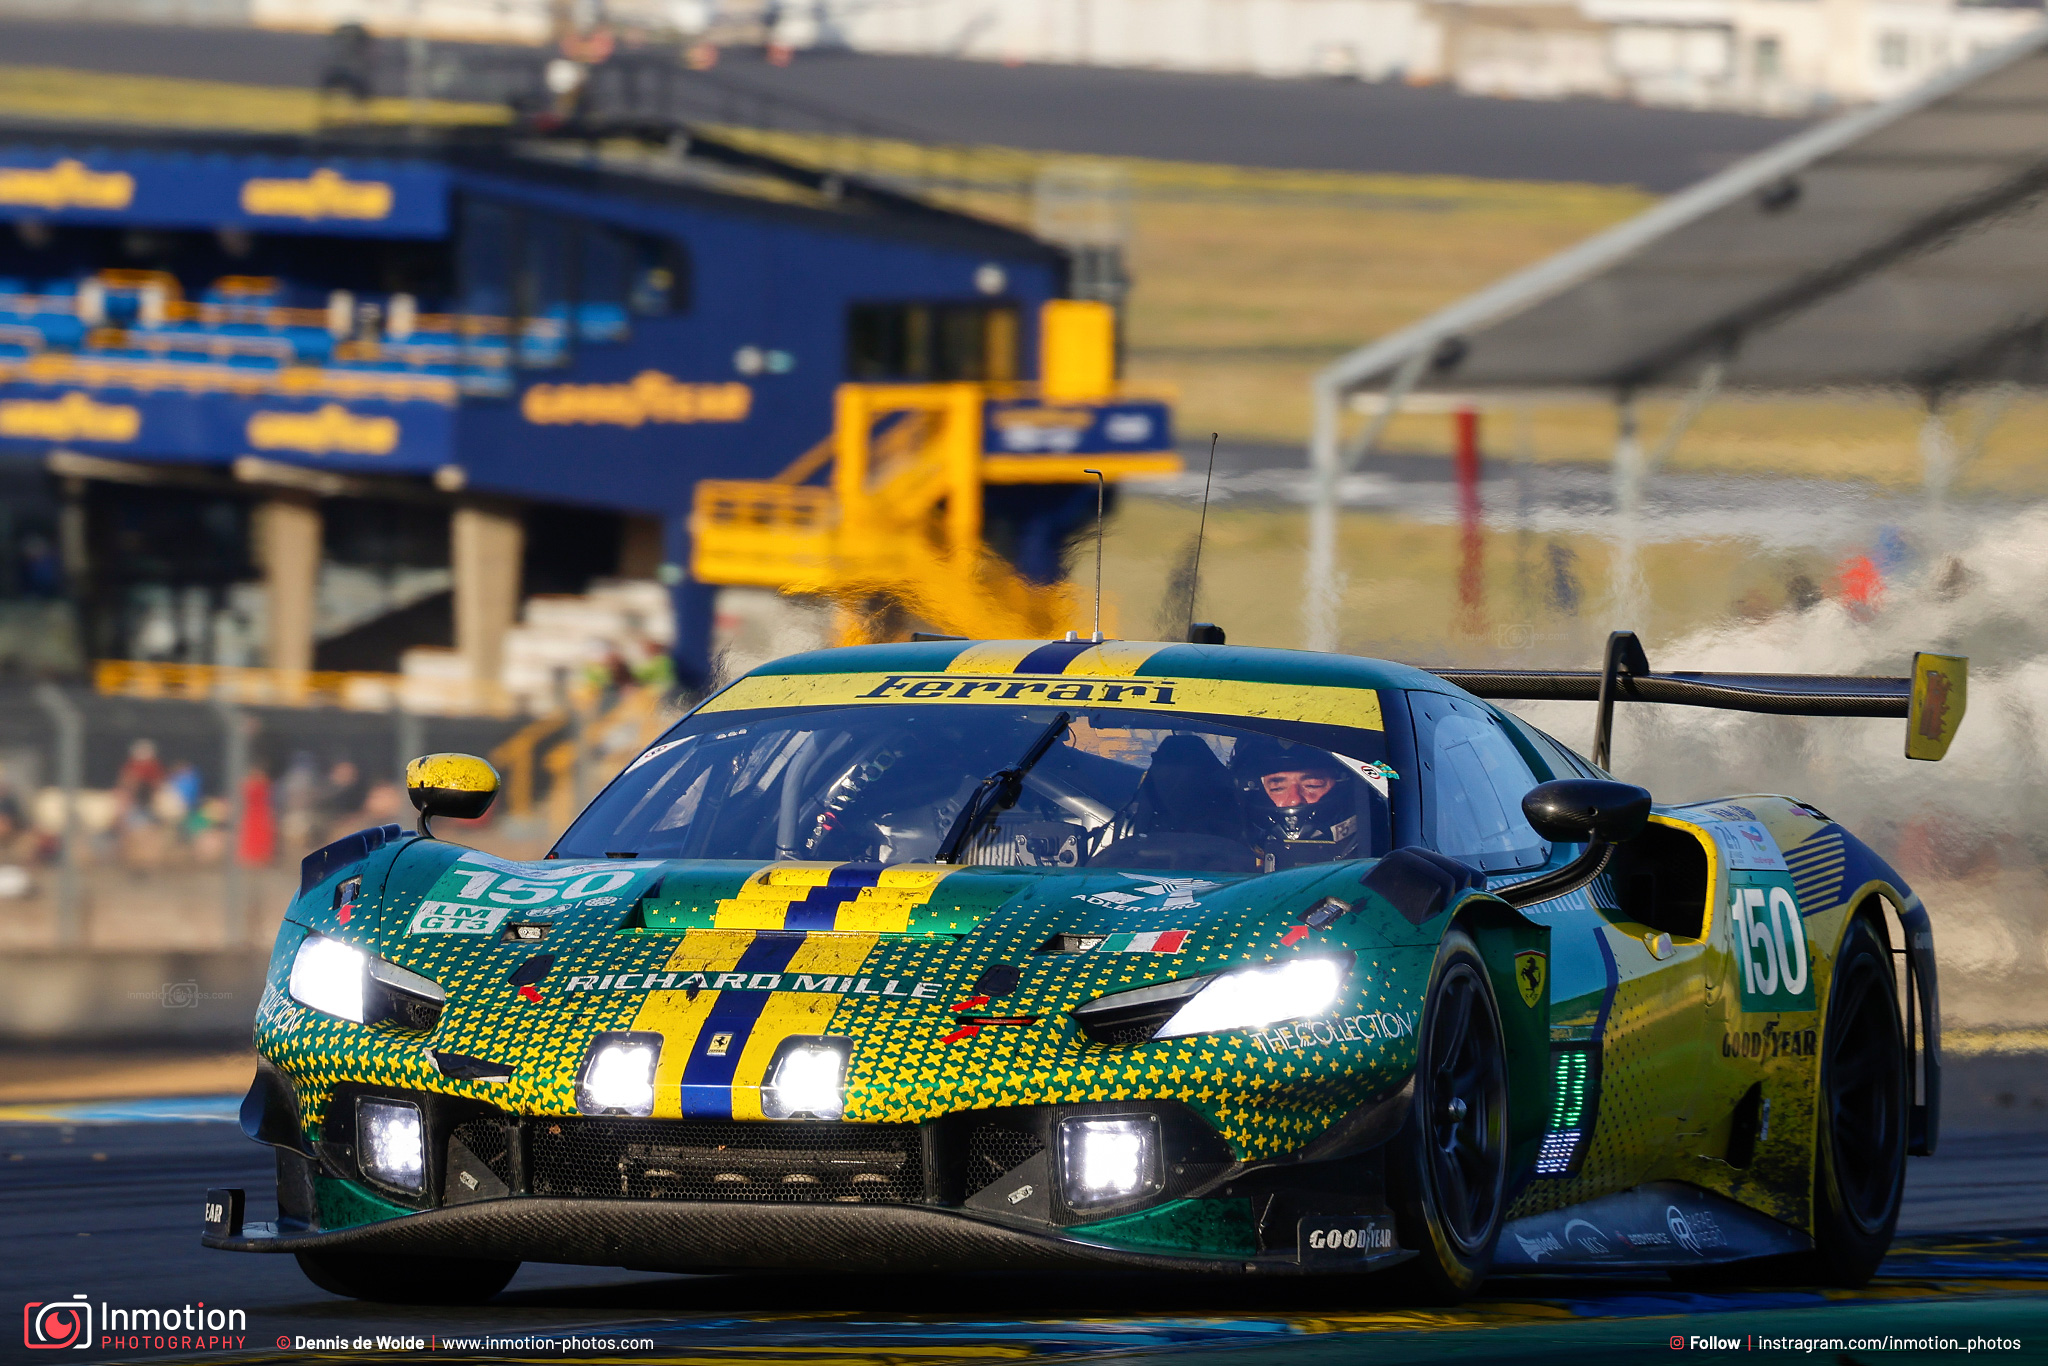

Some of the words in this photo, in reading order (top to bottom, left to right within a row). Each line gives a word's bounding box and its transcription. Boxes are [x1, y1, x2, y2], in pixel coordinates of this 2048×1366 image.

[855, 675, 1178, 704] Ferrari
[453, 869, 636, 905] 150
[434, 904, 492, 919] LM
[1071, 894, 1142, 912] ADLER
[420, 916, 490, 931] GT3
[1731, 886, 1808, 996] 150
[564, 973, 782, 992] RICHARD
[792, 975, 943, 999] MILLE
[1249, 1026, 1299, 1055] THE
[1295, 1012, 1413, 1048] COLLECTION
[1309, 1224, 1392, 1252] GOODYEAR
